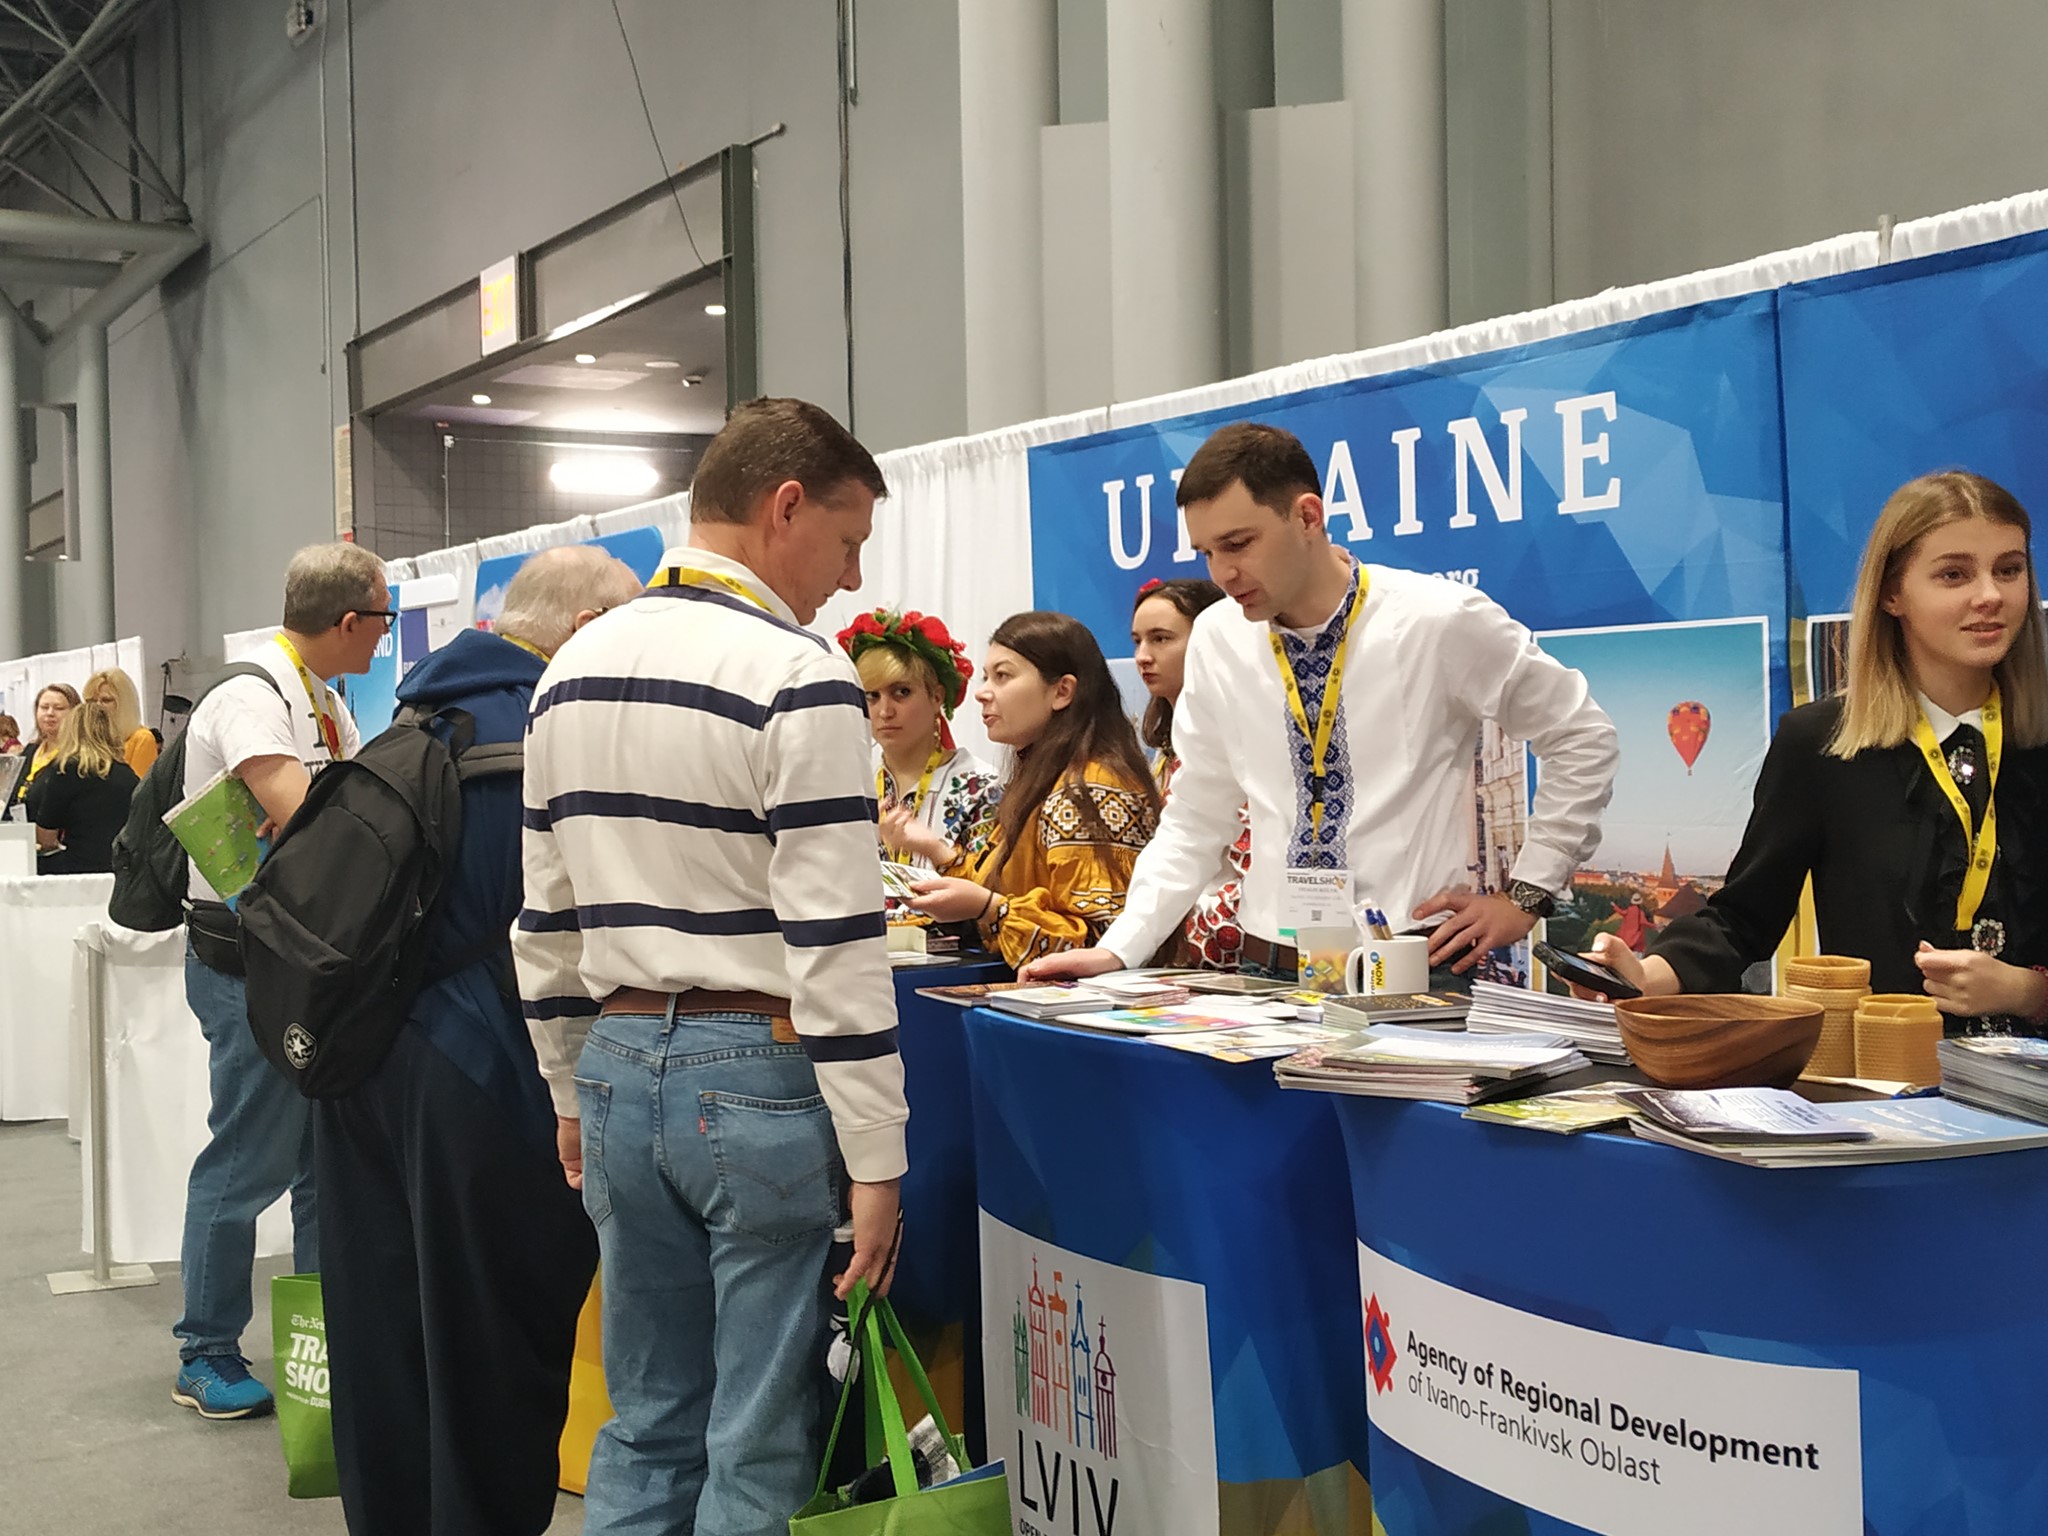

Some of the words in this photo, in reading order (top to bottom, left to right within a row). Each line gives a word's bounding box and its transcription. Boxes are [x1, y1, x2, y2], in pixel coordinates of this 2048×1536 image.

[483, 274, 513, 336] EXIT
[1102, 391, 1622, 570] UAINE
[1432, 568, 1480, 588] rg
[1375, 960, 1383, 986] NOW
[285, 1361, 330, 1394] SHO
[1407, 1330, 1468, 1385] Agency
[1474, 1362, 1494, 1389] of
[1500, 1368, 1601, 1426] Regional
[1610, 1402, 1820, 1471] Development
[1408, 1371, 1423, 1397] of
[1426, 1376, 1574, 1460] Ivano-Frankivsk
[1580, 1437, 1662, 1485] Oblast
[1018, 1428, 1119, 1536] LVIV
